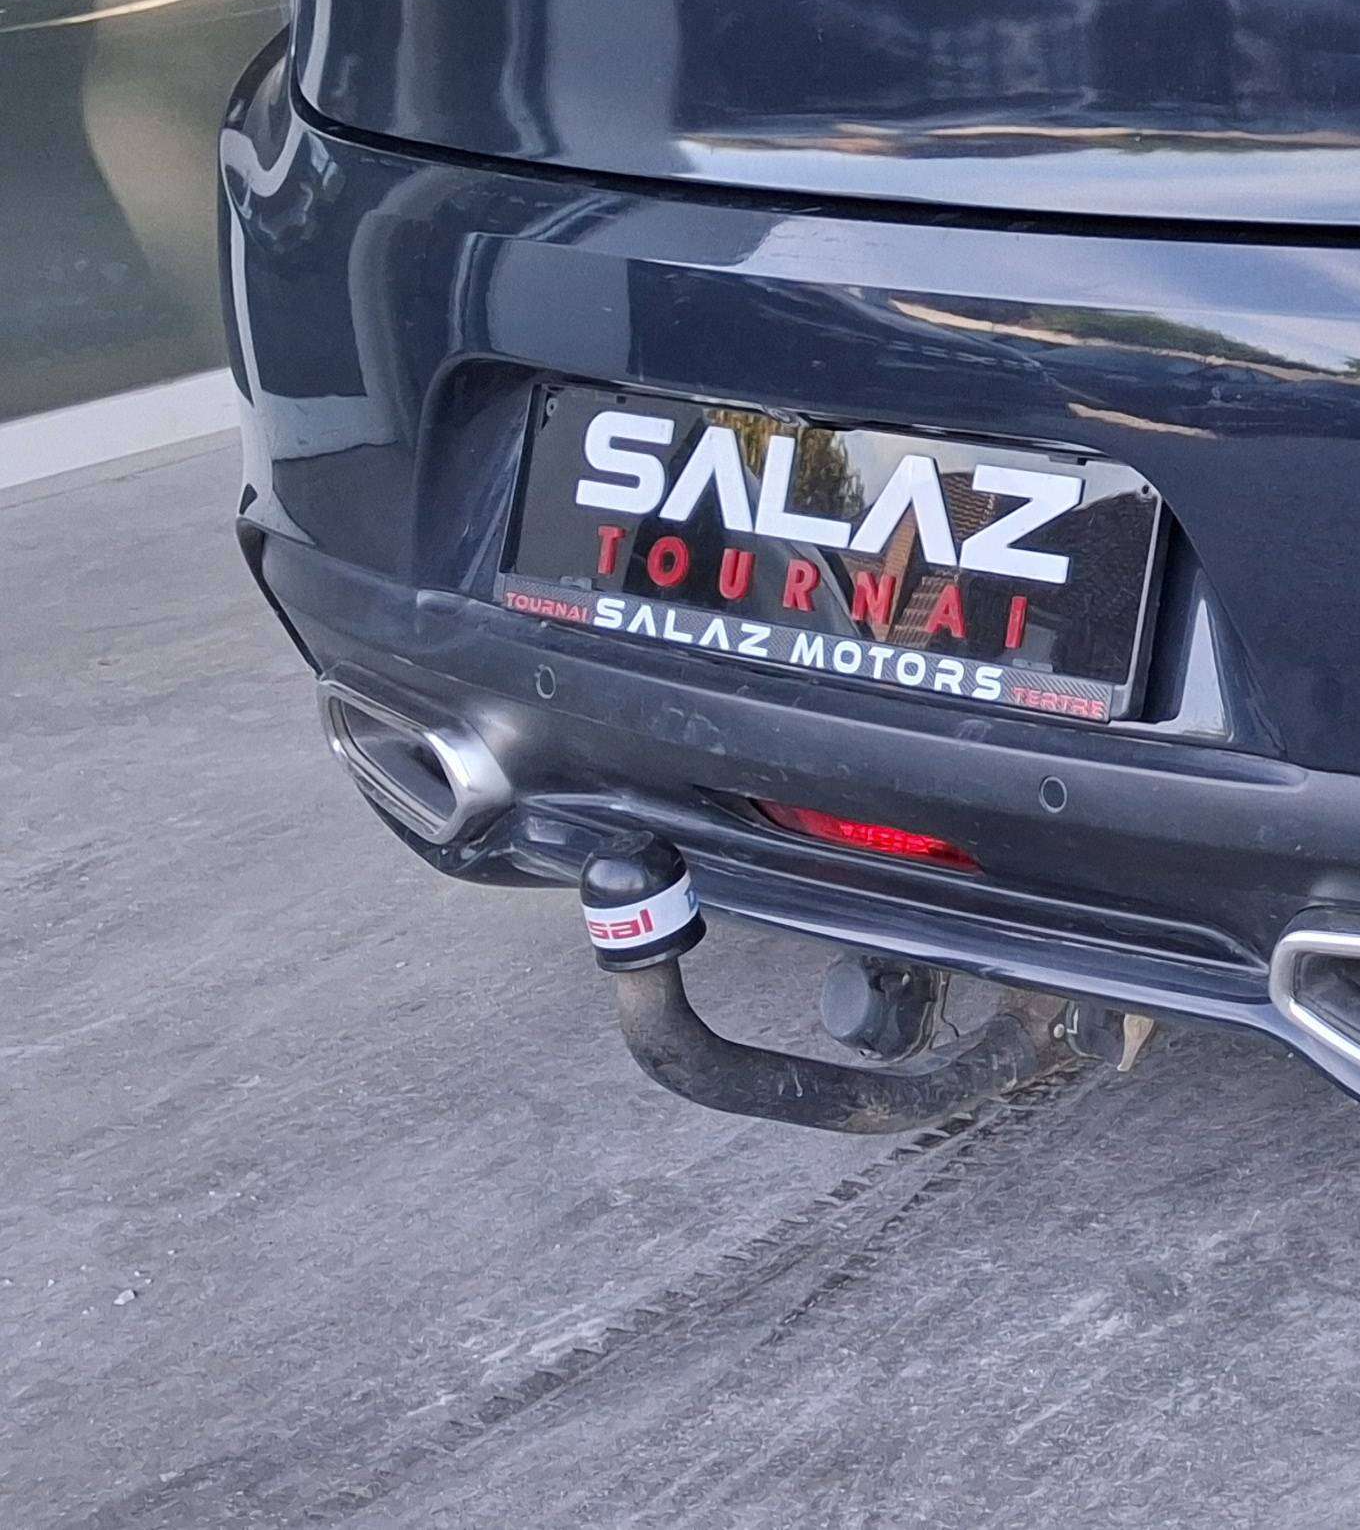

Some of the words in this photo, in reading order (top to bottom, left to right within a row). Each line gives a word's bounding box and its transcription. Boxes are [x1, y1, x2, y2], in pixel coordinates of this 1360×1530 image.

[575, 410, 1085, 585] SALAZ
[505, 591, 588, 623] TOURNAI
[597, 525, 1028, 650] TOURNAI
[593, 598, 770, 658] SALAZ
[789, 633, 1004, 701] MOTORS
[1012, 686, 1106, 719] TERTRE
